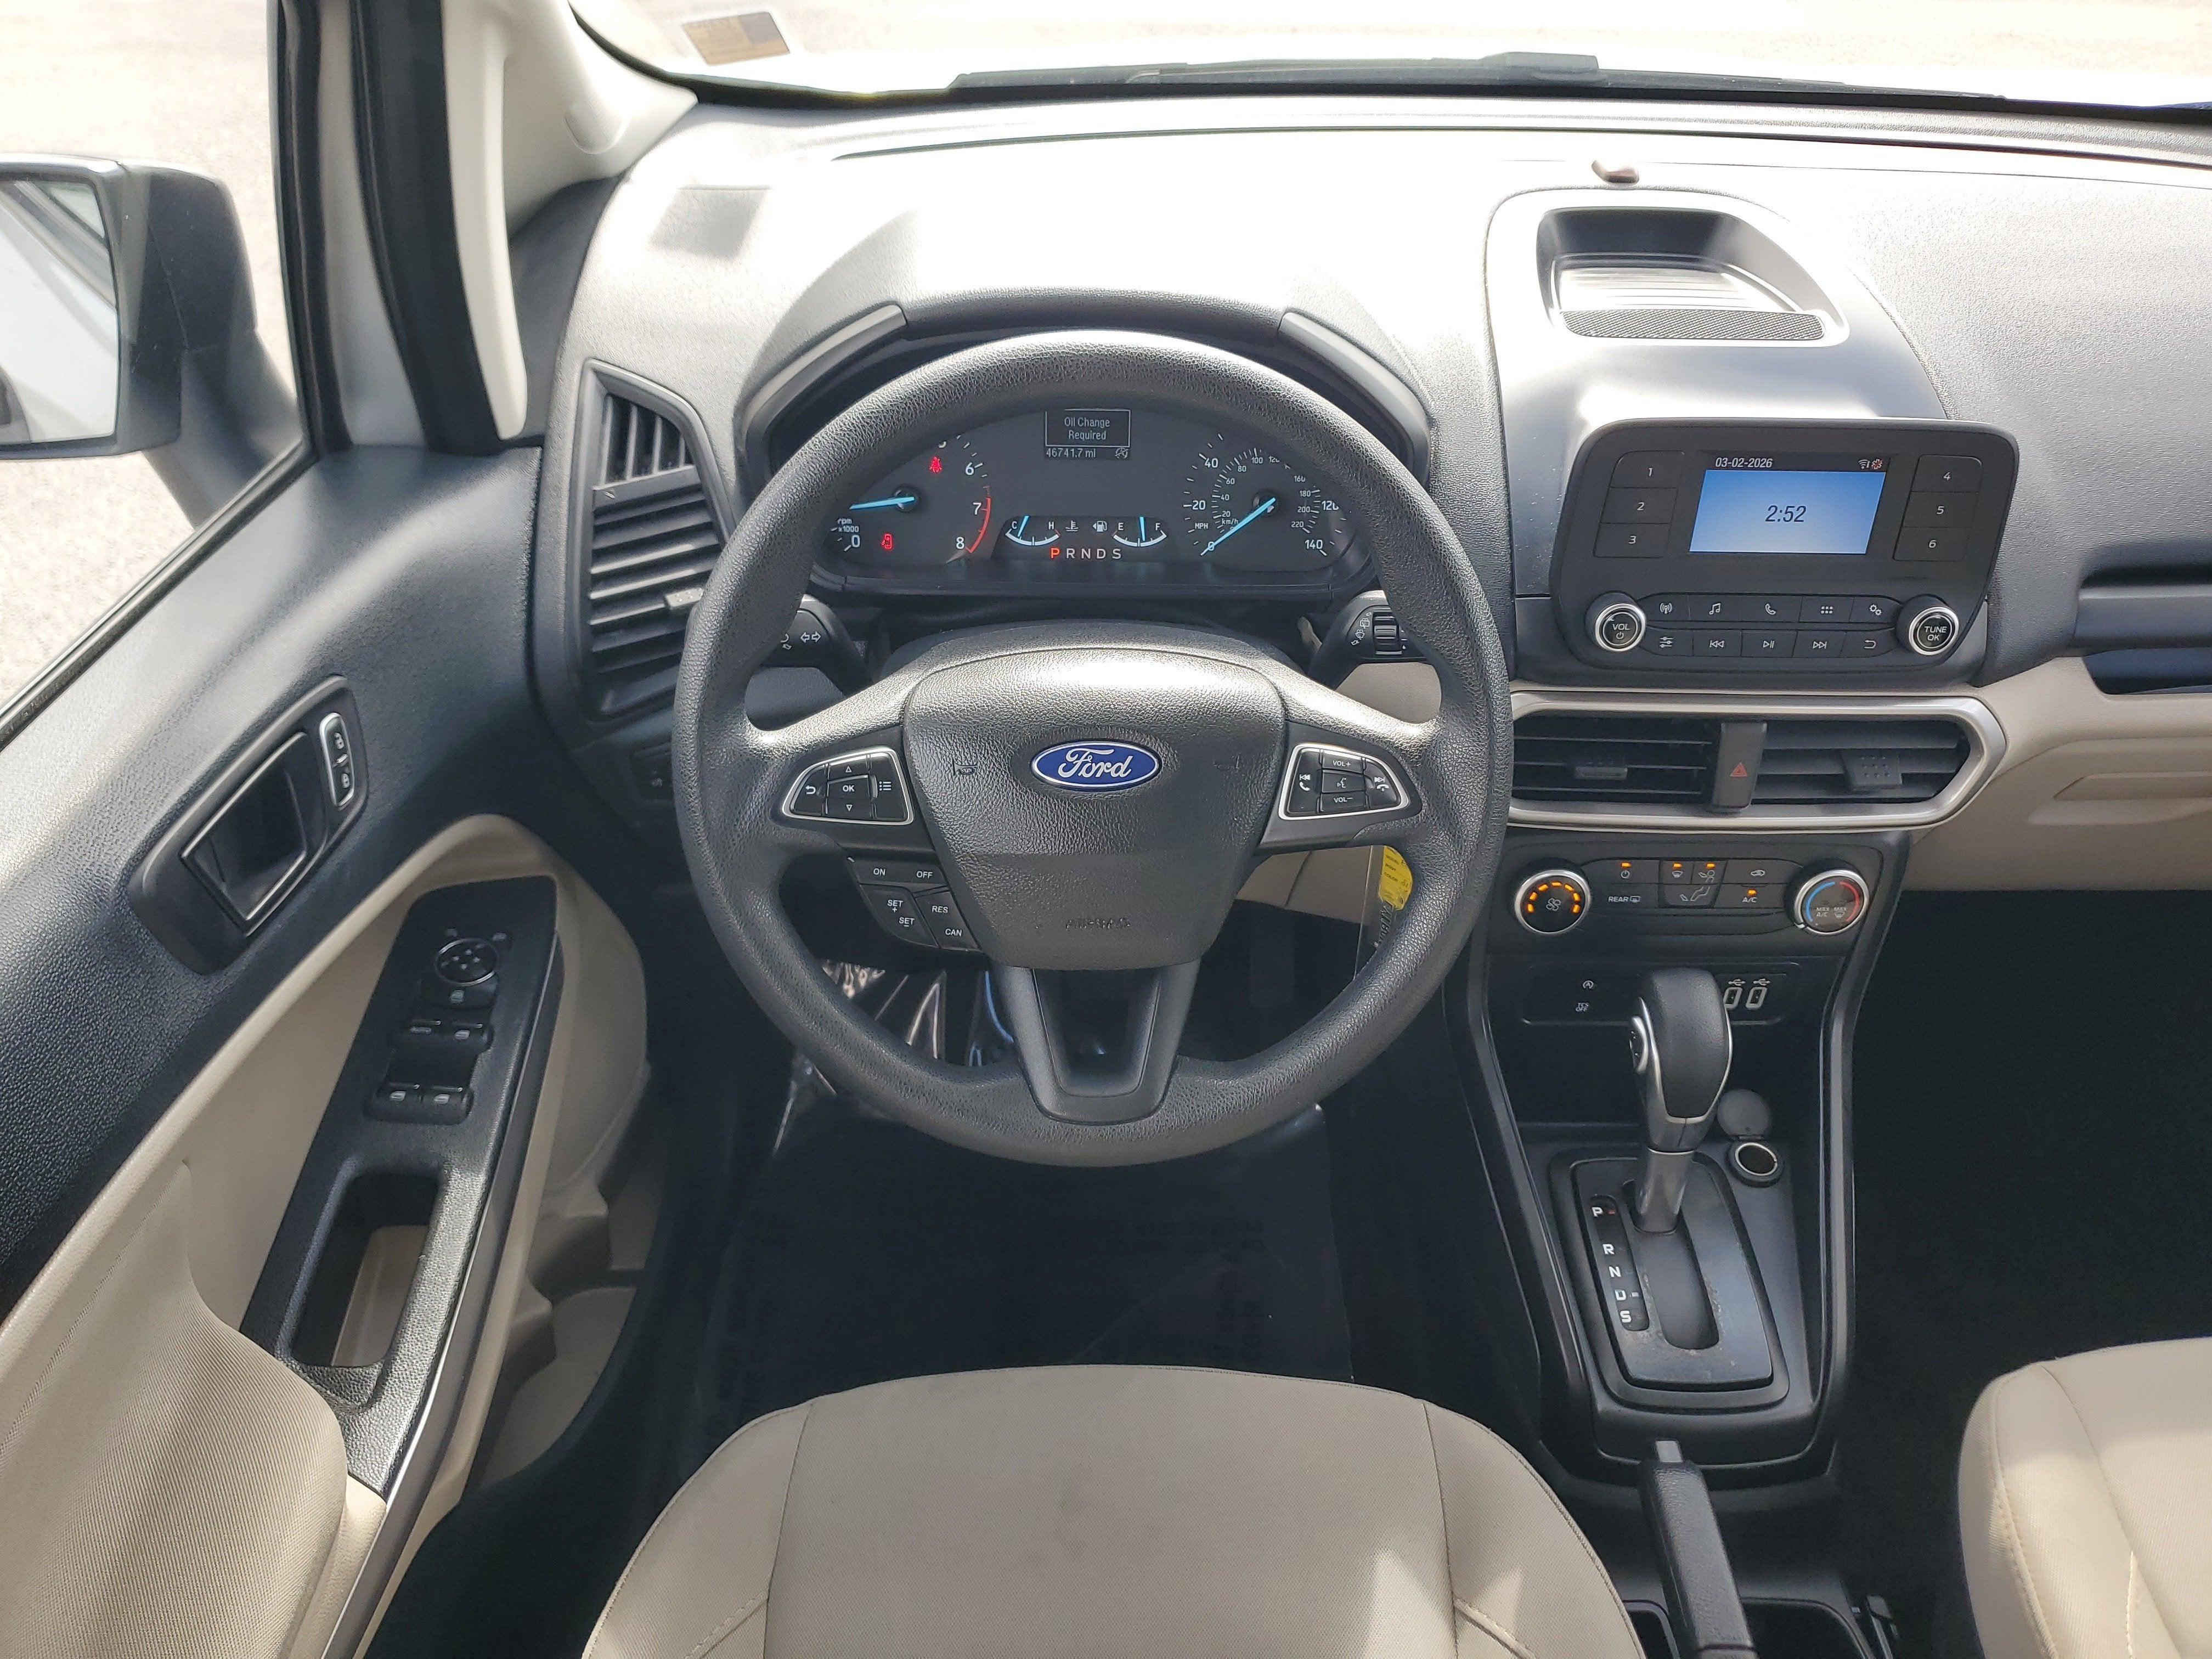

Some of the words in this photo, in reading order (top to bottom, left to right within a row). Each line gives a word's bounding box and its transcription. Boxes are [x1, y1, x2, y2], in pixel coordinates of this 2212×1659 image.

[1064, 417, 1075, 426] Oil
[1077, 417, 1110, 428] Change
[1069, 430, 1107, 441] Required
[1046, 448, 1084, 458] 46741.7
[1085, 448, 1096, 458] mi
[1204, 458, 1218, 468] 40
[1715, 458, 1773, 467] 03-02-2026
[966, 462, 974, 475] 6
[1649, 467, 1654, 477] 1
[1943, 472, 1951, 481] 4
[973, 502, 982, 515] 7
[1192, 500, 1206, 510] 20
[1637, 502, 1645, 511] 2
[1765, 505, 1807, 522] 2:52
[1936, 506, 1944, 515] 5
[1012, 521, 1017, 529] C
[1048, 522, 1054, 530] H
[1155, 522, 1161, 531] F
[851, 534, 860, 548] 0
[956, 537, 964, 549] 8
[1305, 539, 1323, 549] 140
[1628, 535, 1637, 544] 3
[1929, 539, 1937, 548] 6
[1050, 548, 1060, 558] P
[1066, 549, 1075, 559] R
[1081, 549, 1091, 559] N
[1097, 549, 1106, 559] D
[1112, 549, 1121, 559] S
[1058, 748, 1133, 778] Ford
[916, 871, 933, 879] OFF
[887, 899, 904, 907] SET
[932, 905, 949, 913] RES
[899, 917, 915, 926] SET
[945, 928, 962, 936] CAN
[1591, 1206, 1604, 1217] P
[1602, 1244, 1615, 1255] R
[1609, 1266, 1621, 1278] N
[1615, 1289, 1627, 1301] D
[1620, 1310, 1632, 1323] S
